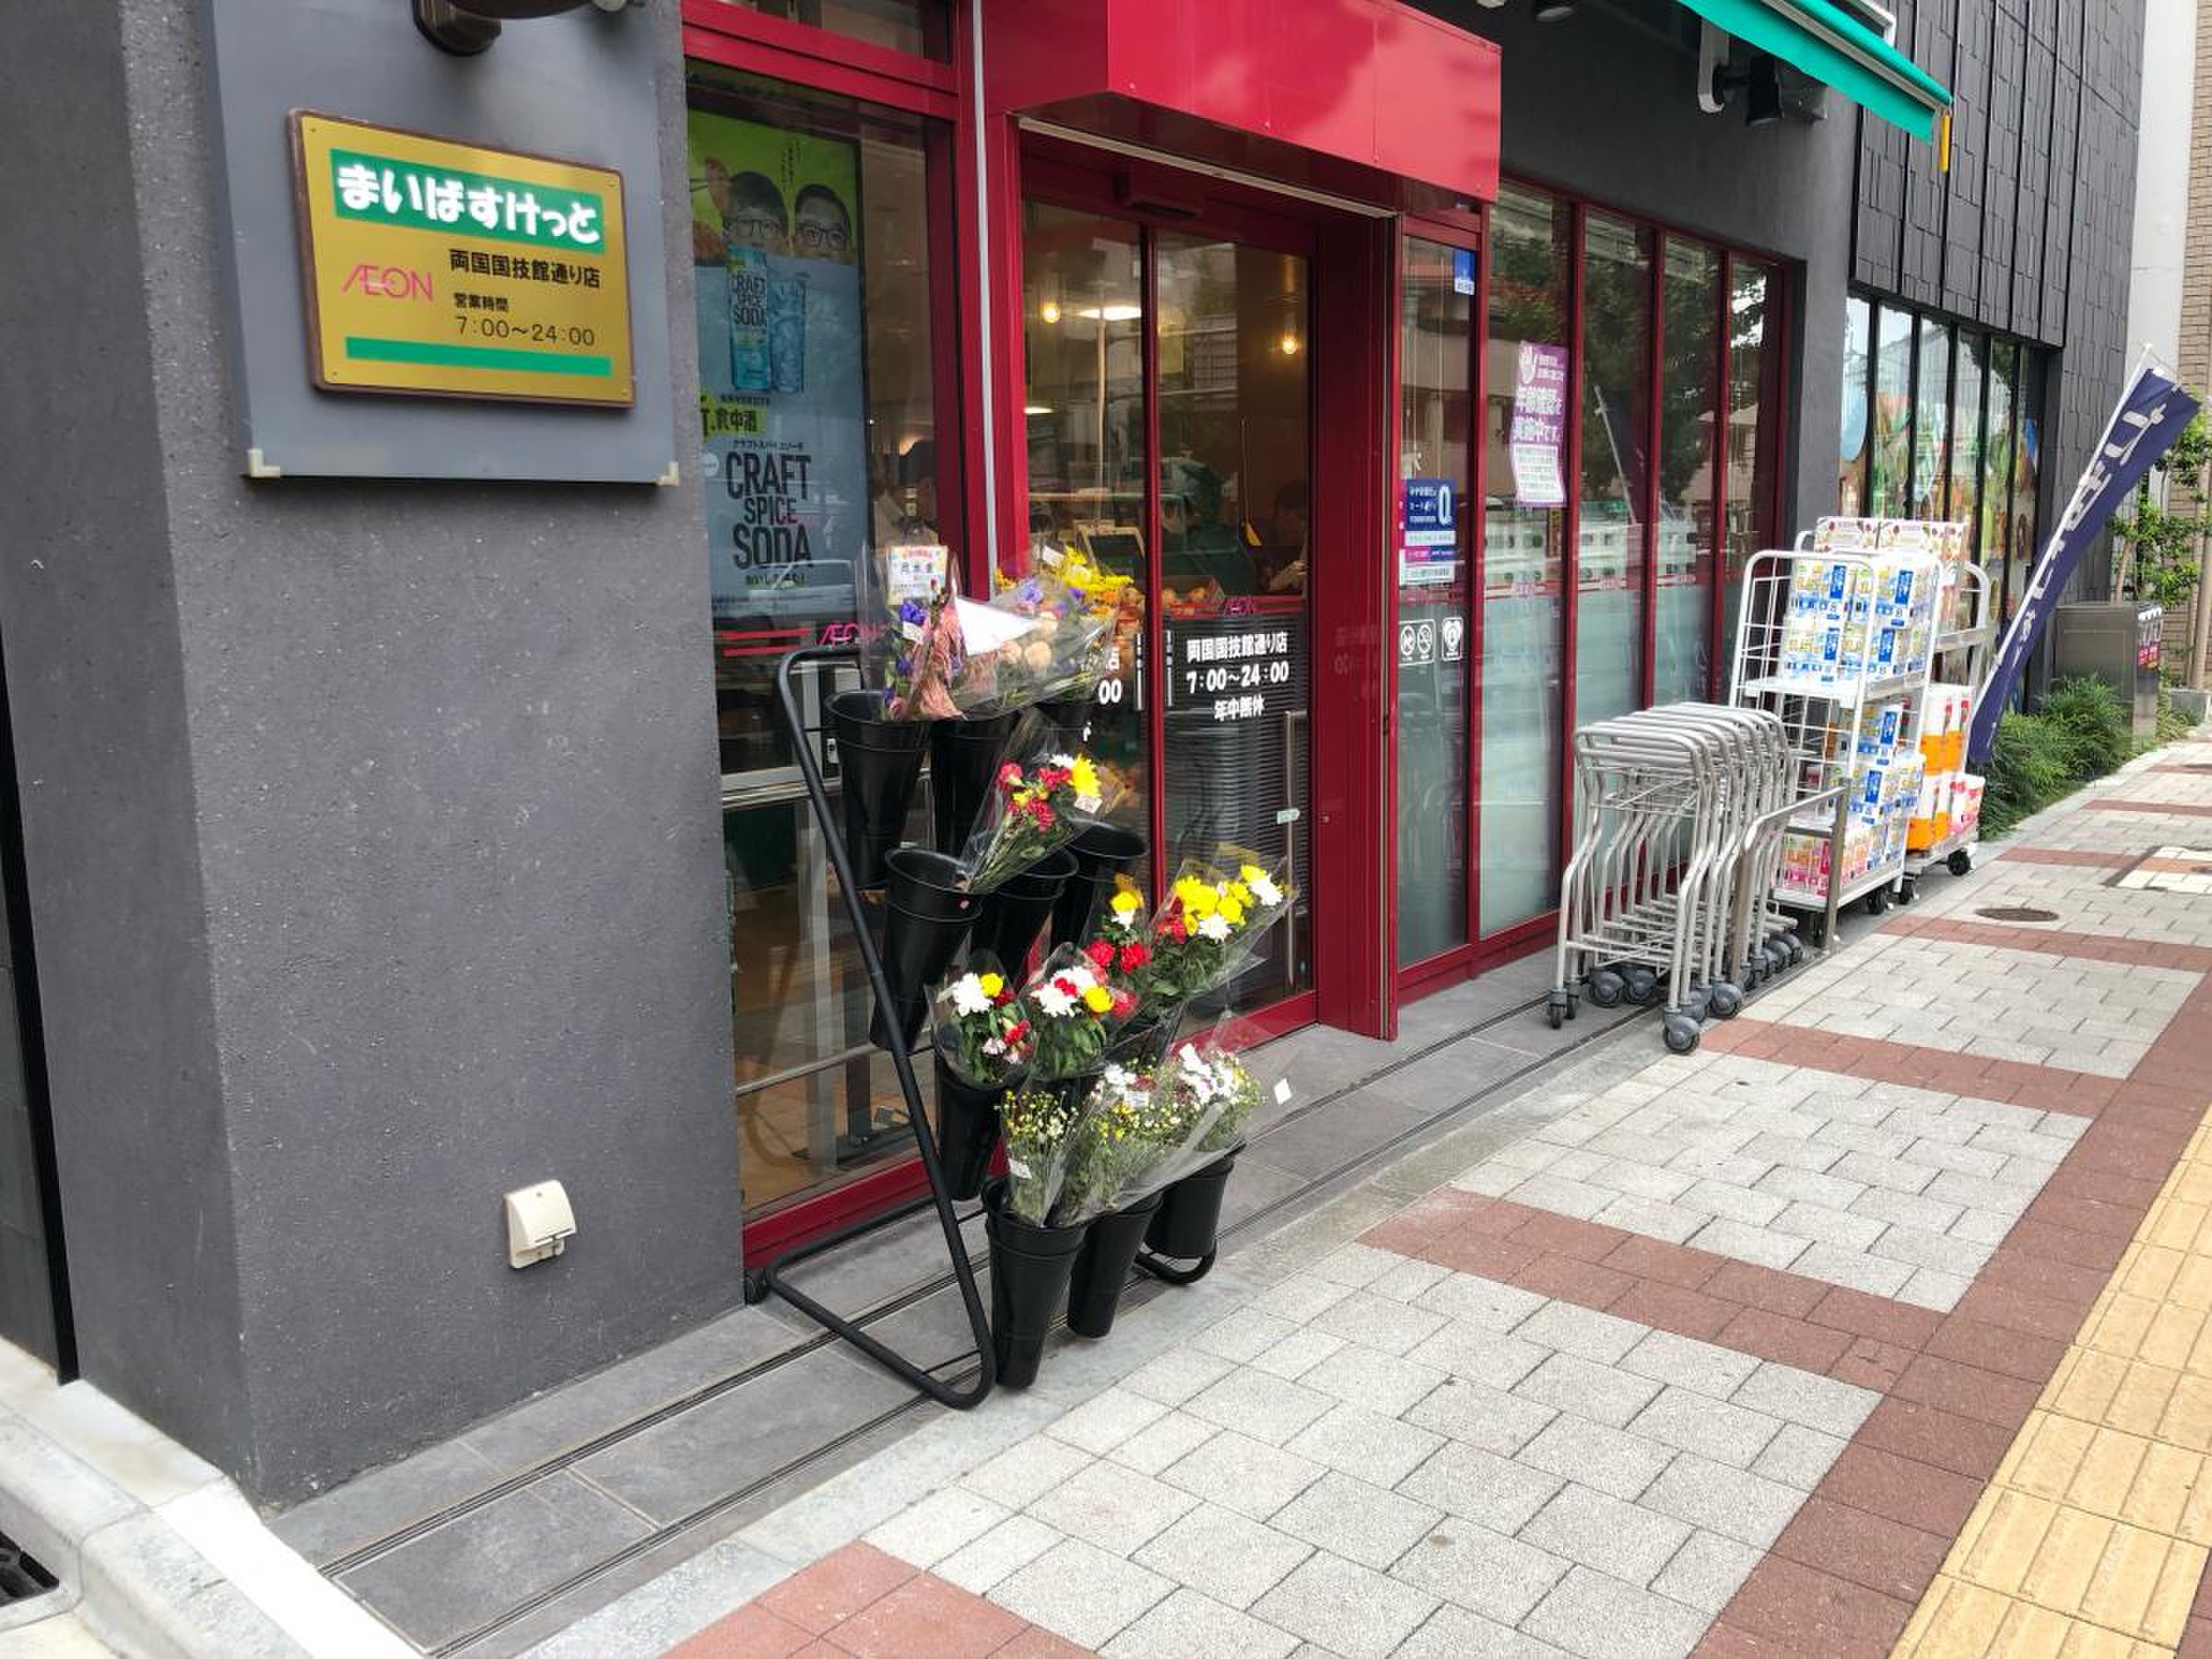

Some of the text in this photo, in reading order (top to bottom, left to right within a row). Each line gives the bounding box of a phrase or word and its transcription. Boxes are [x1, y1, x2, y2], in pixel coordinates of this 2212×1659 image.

[338, 164, 600, 243] まいばすけっと
[449, 249, 601, 288] 両国国技館通り店
[453, 293, 509, 312] 営業時間
[726, 451, 812, 500] CRAFT
[744, 497, 798, 525] SPICE
[733, 524, 813, 570] SODA
[1187, 631, 1288, 663] 両国国技館通り店
[1214, 694, 1265, 722] 年中無休
